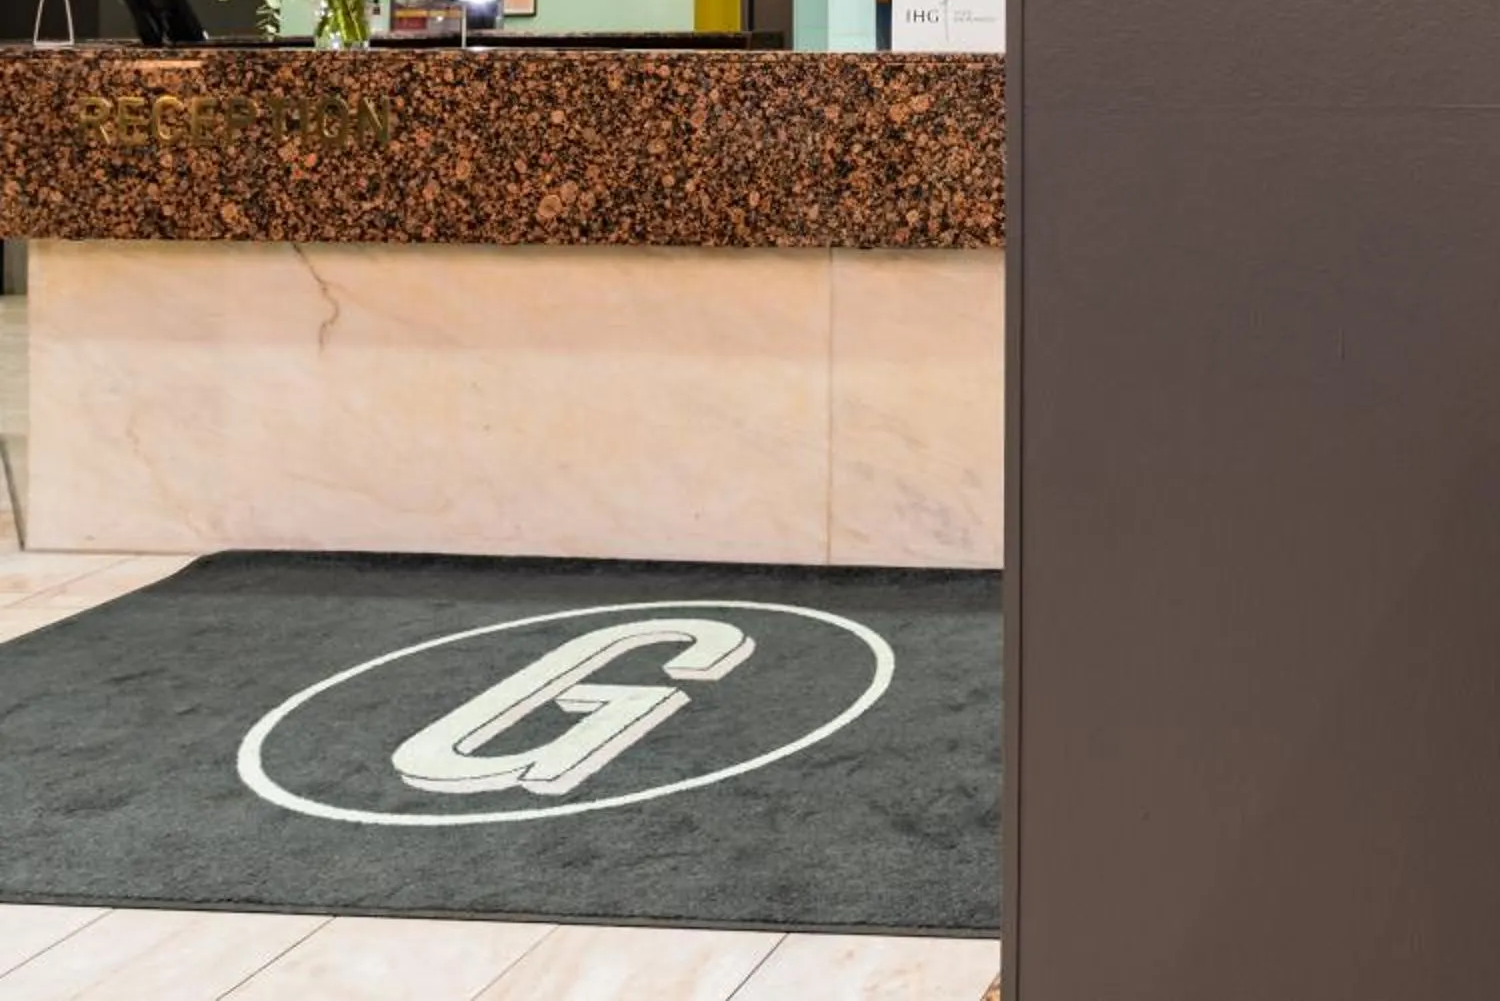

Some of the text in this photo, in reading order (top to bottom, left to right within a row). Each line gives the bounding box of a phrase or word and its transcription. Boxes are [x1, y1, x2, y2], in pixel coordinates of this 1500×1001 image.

[905, 8, 939, 23] IHG
[78, 95, 391, 146] RECEPTION
[392, 618, 755, 795] G
